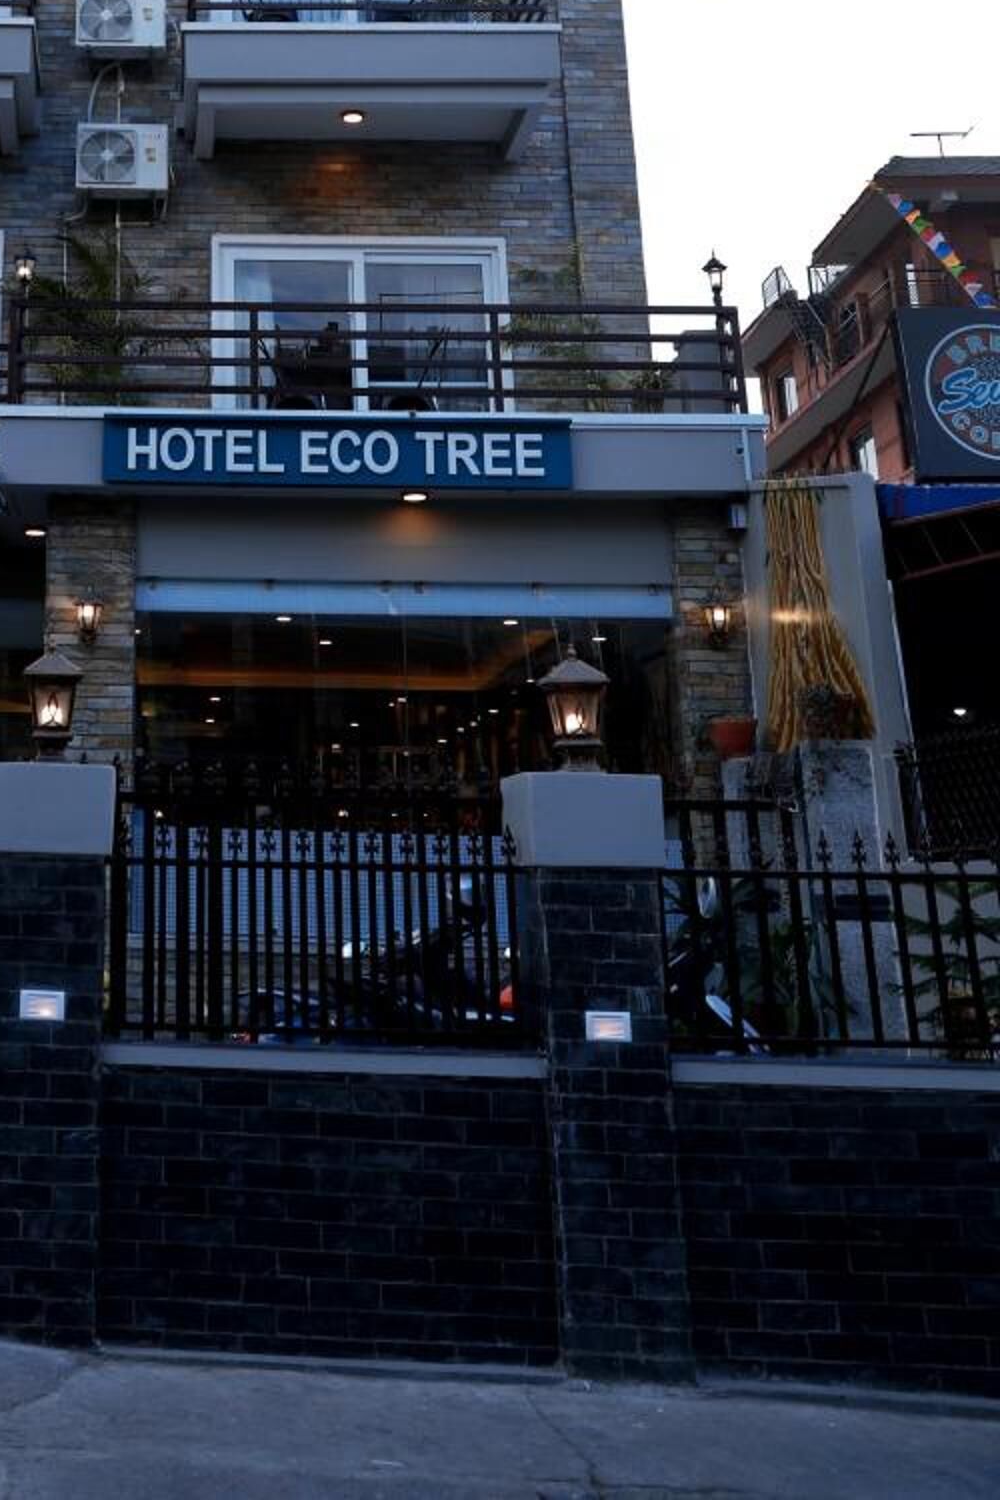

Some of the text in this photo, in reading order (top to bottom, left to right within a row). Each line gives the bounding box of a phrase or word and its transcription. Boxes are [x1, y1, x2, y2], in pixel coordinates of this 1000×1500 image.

[127, 427, 545, 477] HOTEL ECO TREE
